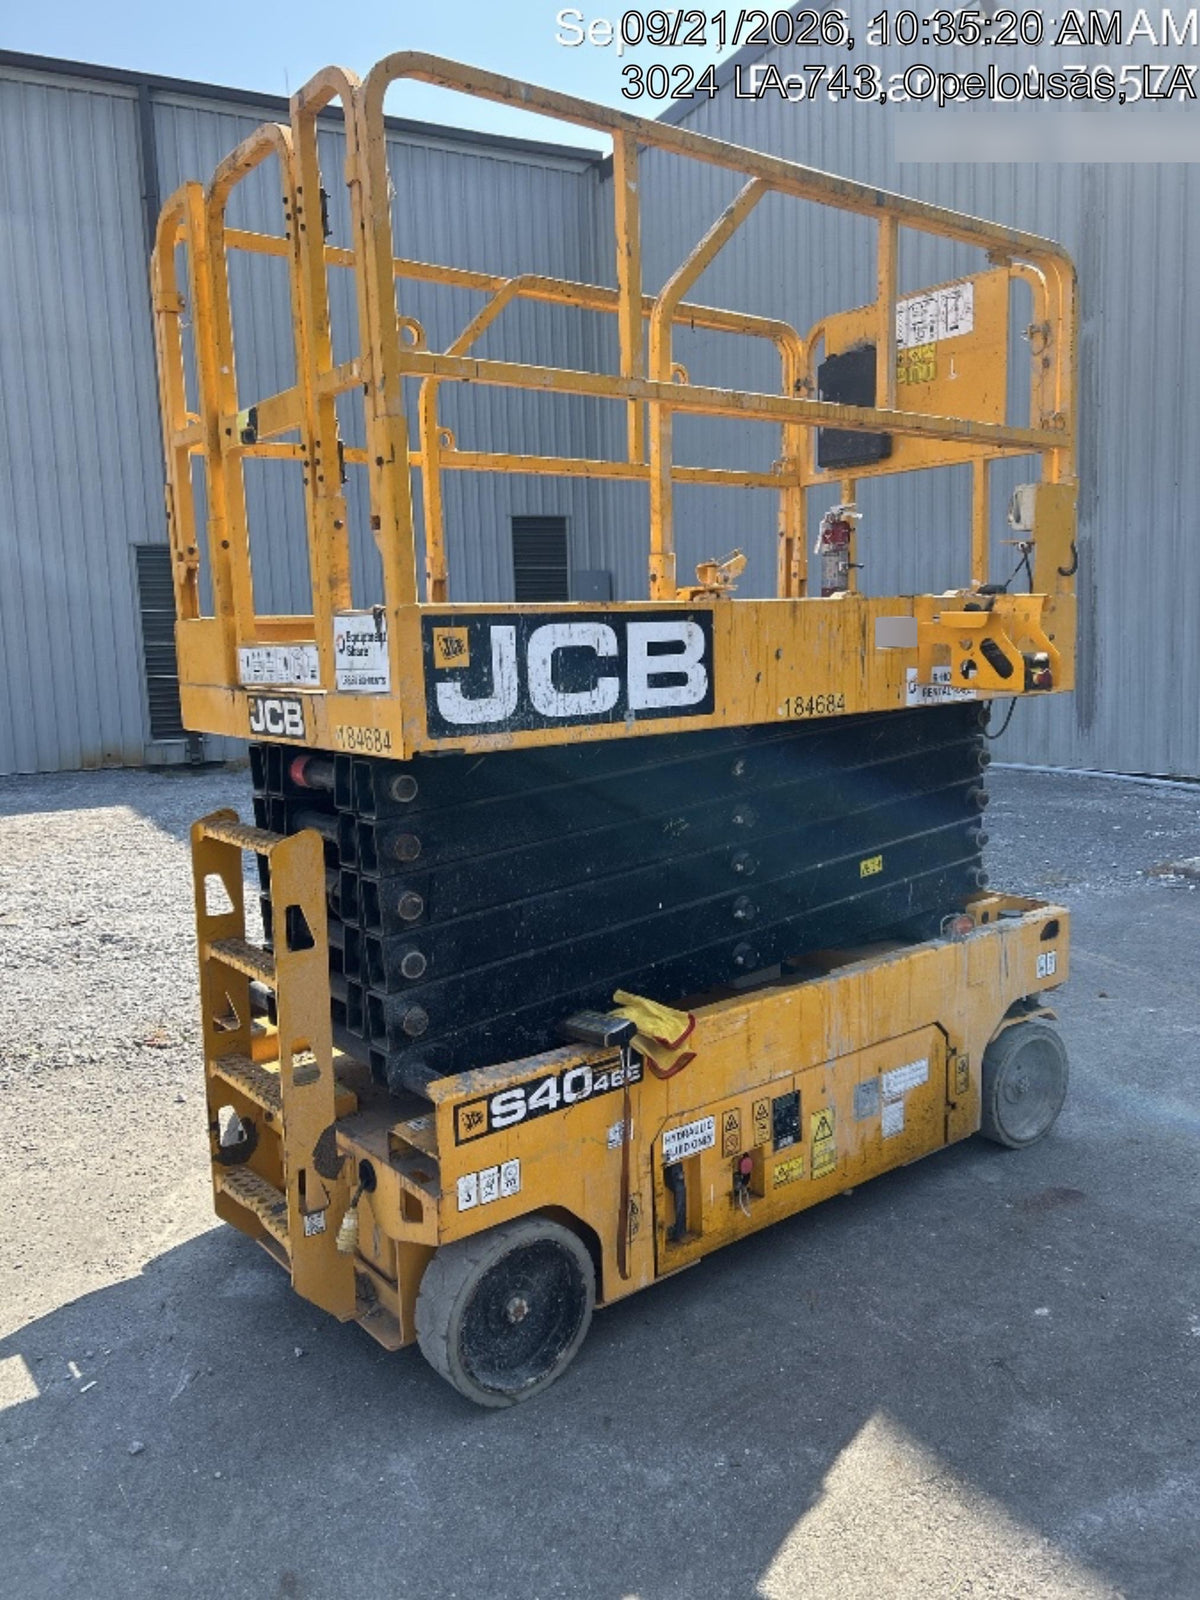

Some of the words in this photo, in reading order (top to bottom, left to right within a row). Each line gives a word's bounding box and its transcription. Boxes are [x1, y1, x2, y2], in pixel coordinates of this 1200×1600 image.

[436, 621, 708, 724] JCB
[250, 697, 304, 736] JCB
[785, 693, 845, 717] 184684
[339, 726, 391, 753] 184684
